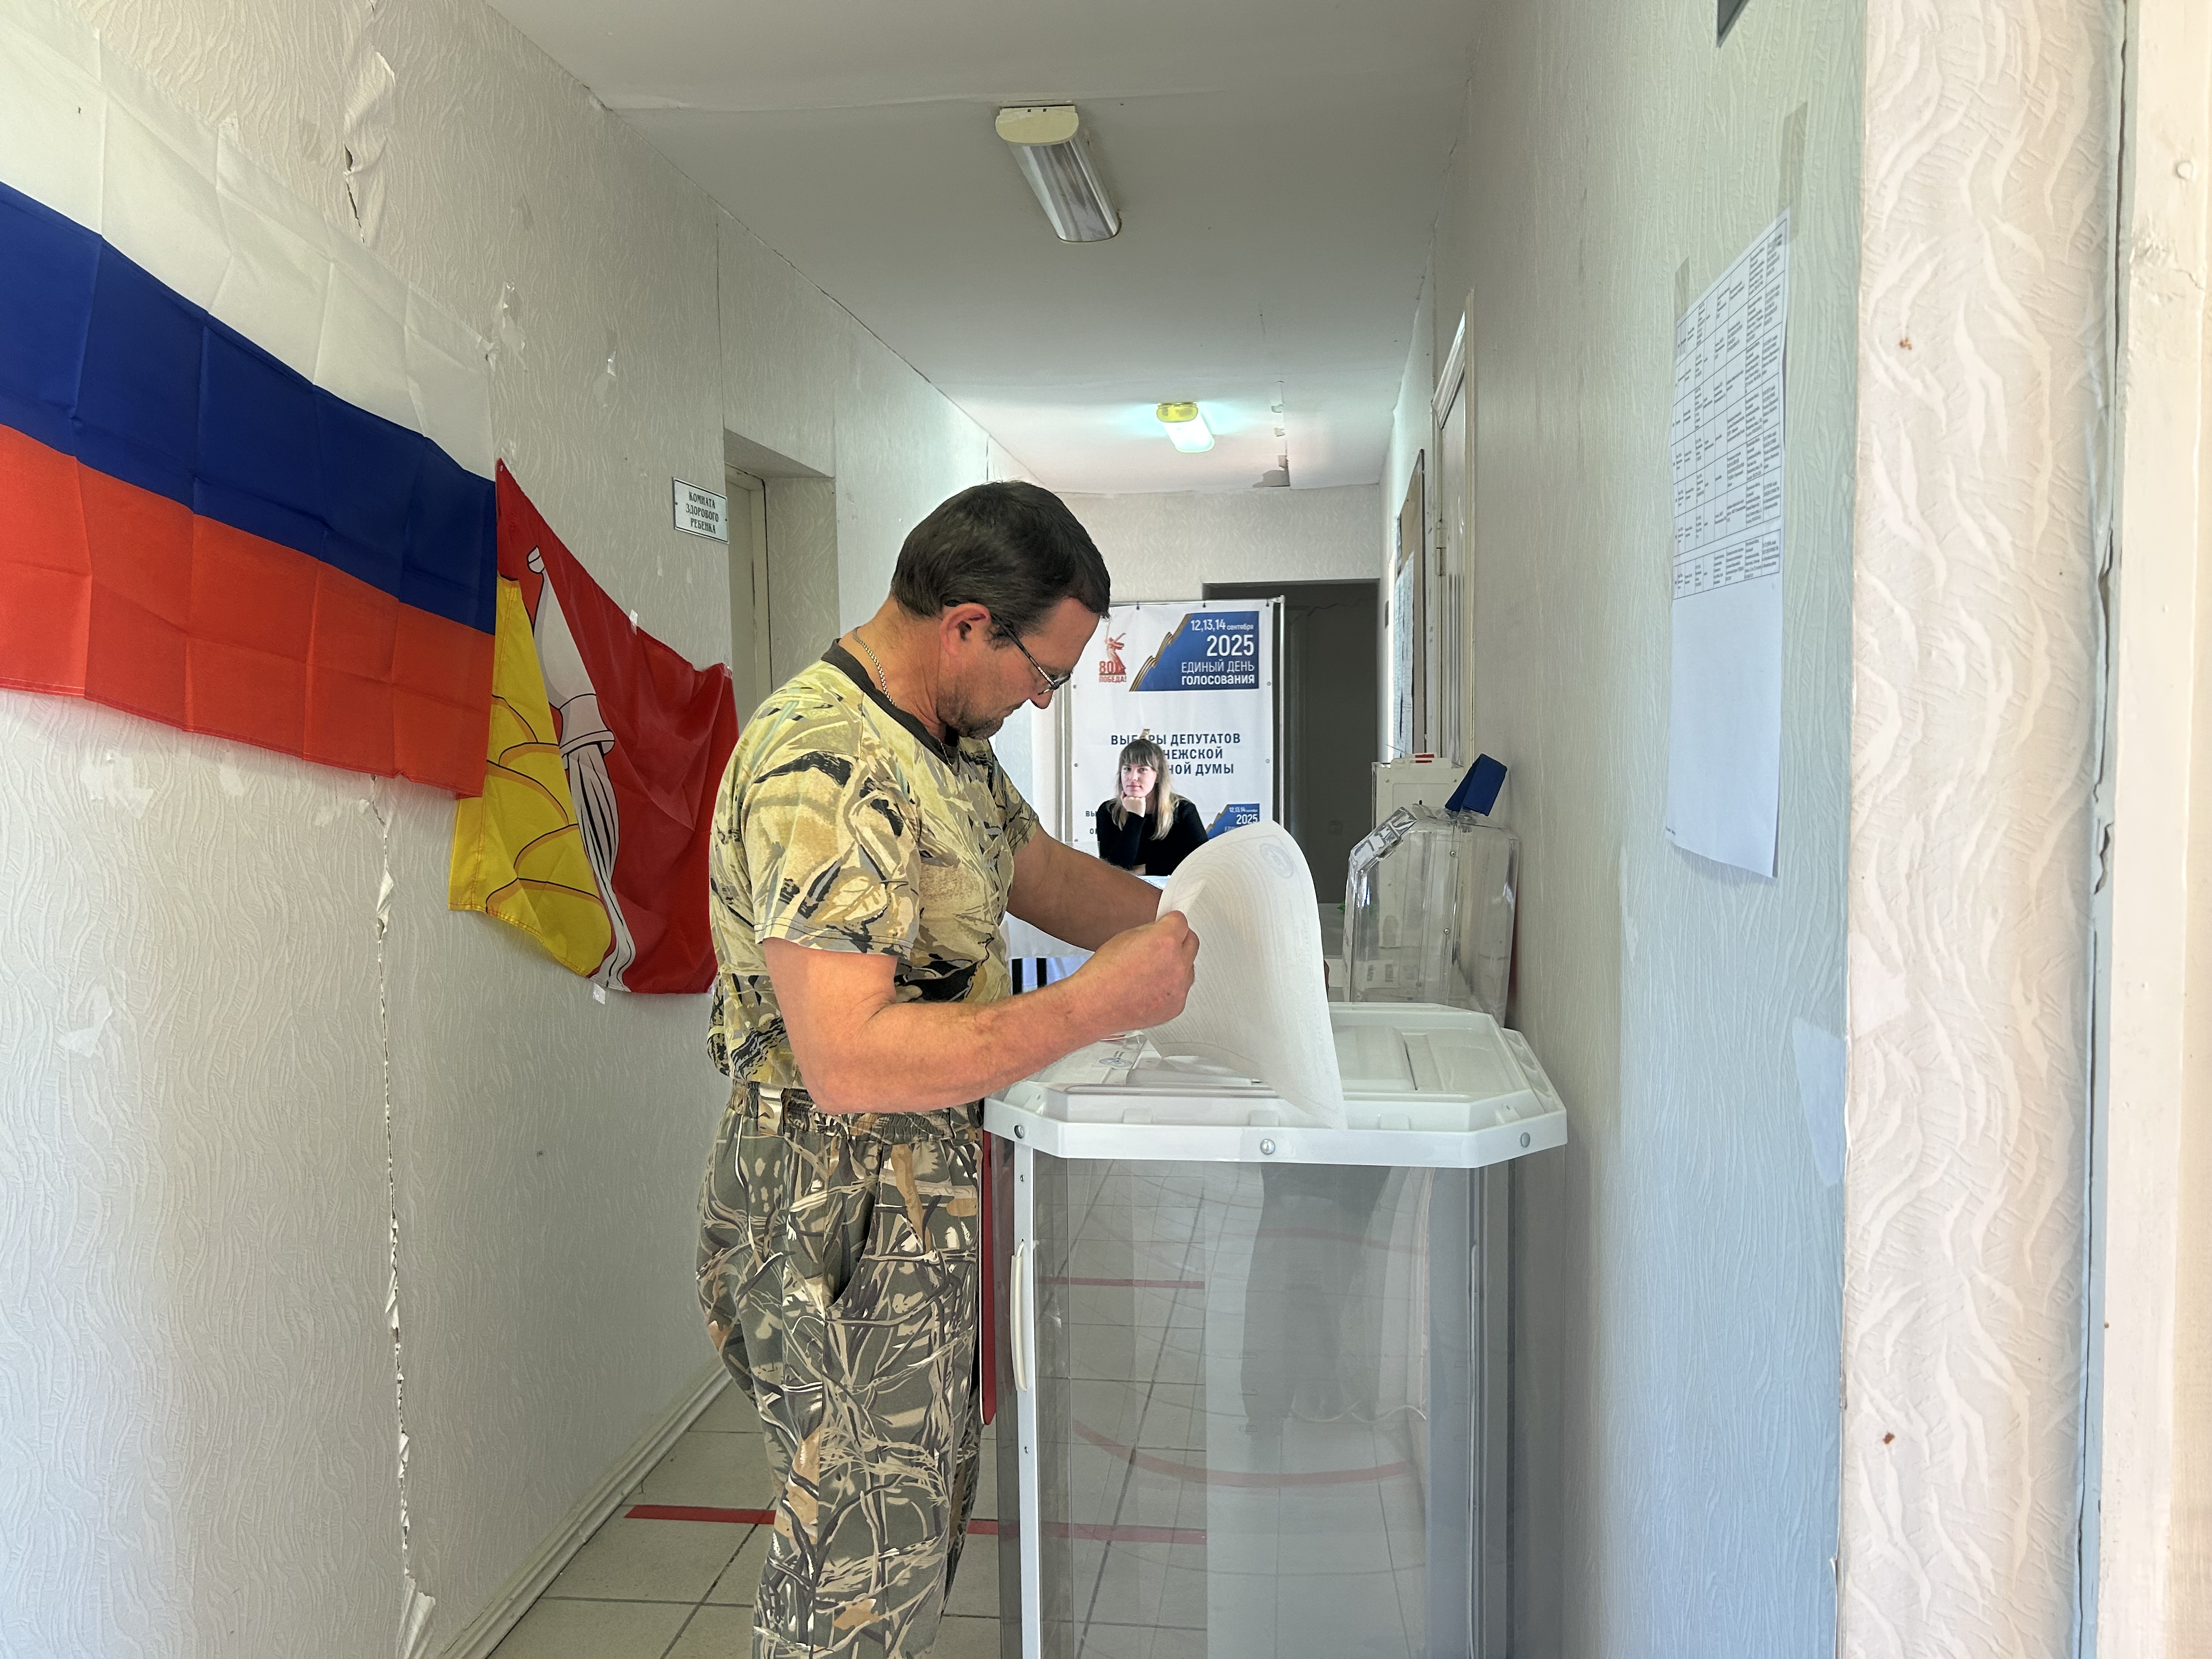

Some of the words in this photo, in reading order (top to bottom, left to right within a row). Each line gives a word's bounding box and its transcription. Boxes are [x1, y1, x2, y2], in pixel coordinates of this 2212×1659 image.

[689, 492, 715, 509] КОМНАТА
[686, 504, 719, 522] ЗДОРОВОГО
[690, 518, 716, 534] РЕБЕНКА
[1190, 619, 1226, 632] 12,13,14
[1206, 634, 1254, 657] 2025
[1099, 661, 1114, 674] 80
[1181, 658, 1224, 674] ЕДИНЫЙ
[1227, 661, 1255, 673] ДЕНЬ
[1171, 733, 1241, 747] ДЕПУТАТОВ
[1163, 746, 1223, 760] НЕЖСКОЙ
[1195, 763, 1234, 776] ДУМЫ
[1236, 814, 1258, 825] 2025
